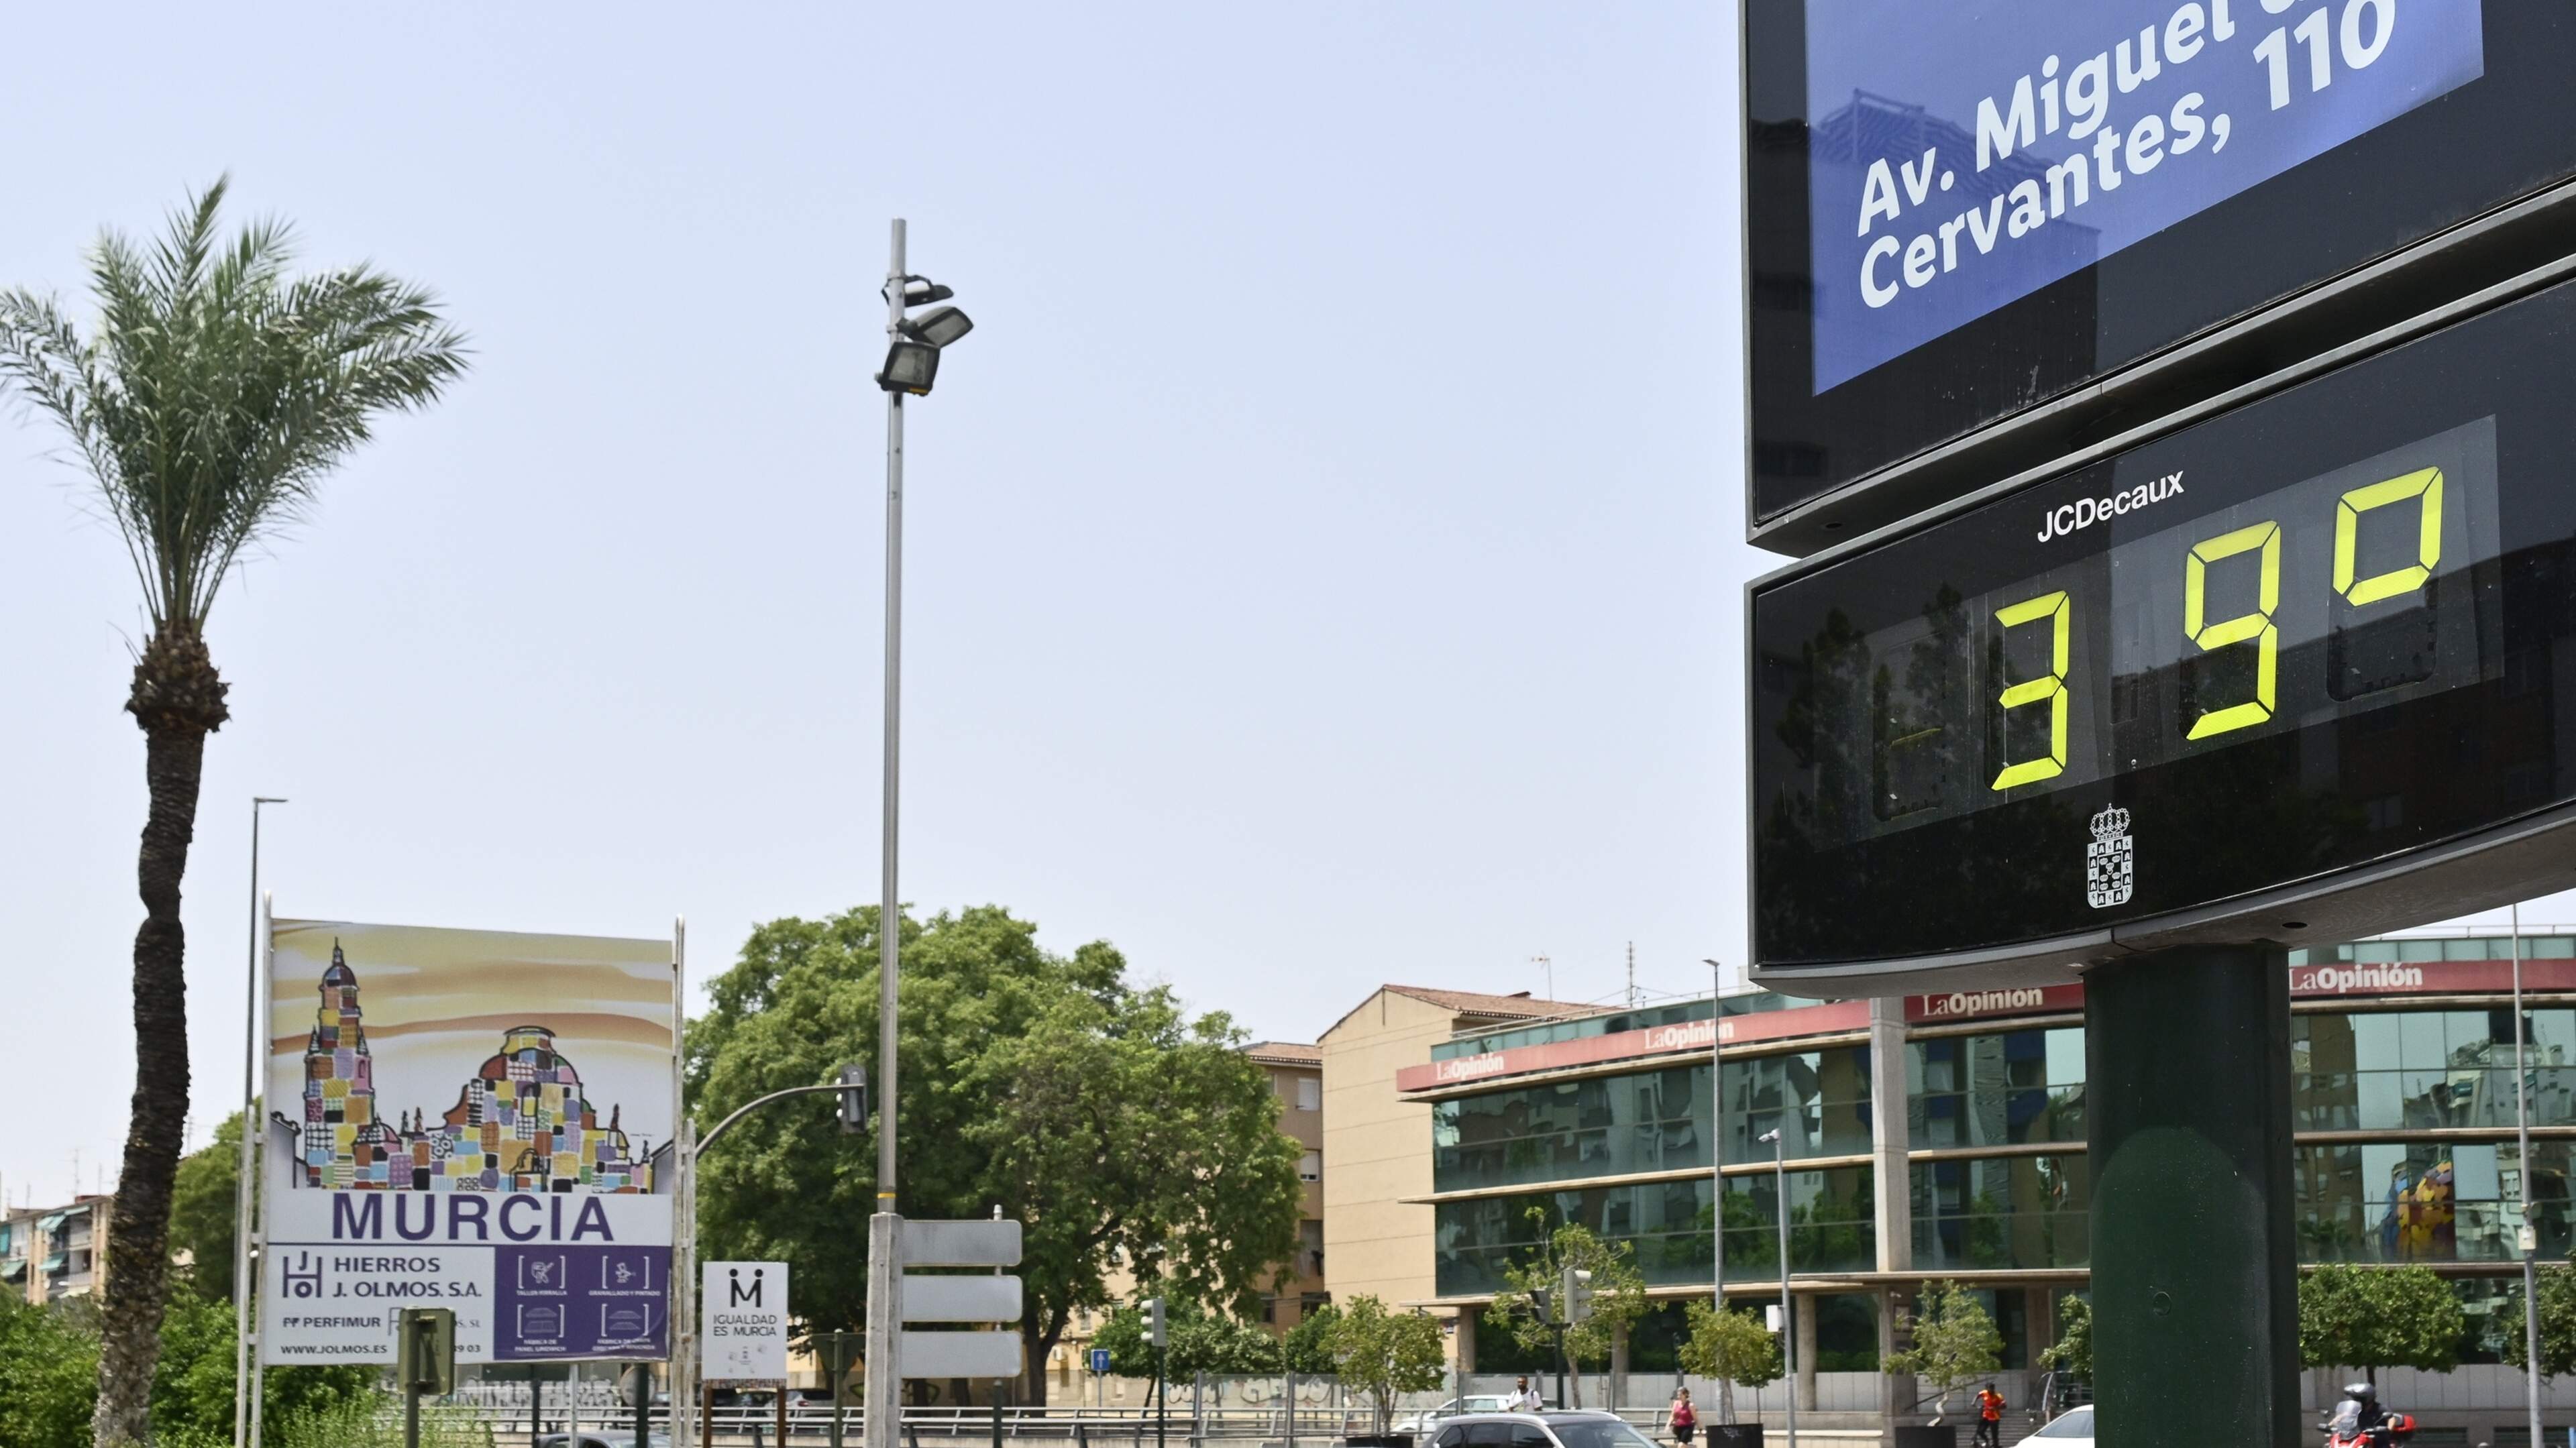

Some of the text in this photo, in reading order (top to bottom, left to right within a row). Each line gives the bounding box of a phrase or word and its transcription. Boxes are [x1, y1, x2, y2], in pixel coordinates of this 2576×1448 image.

[1860, 0, 2396, 308] Cervantes, 110
[1858, 147, 1954, 237] Av.
[2037, 470, 2184, 543] JCDecaux
[332, 1192, 614, 1242] MURCIA
[334, 1256, 441, 1273] HIERROS
[332, 1281, 347, 1298] J.
[448, 1281, 482, 1298] S.A.
[303, 1317, 381, 1328] PERFIMUR
[713, 1315, 777, 1325] IGUALDAD
[713, 1327, 777, 1337] ES MURCIA
[280, 1345, 388, 1354] WWW.JOLMOS.ES
